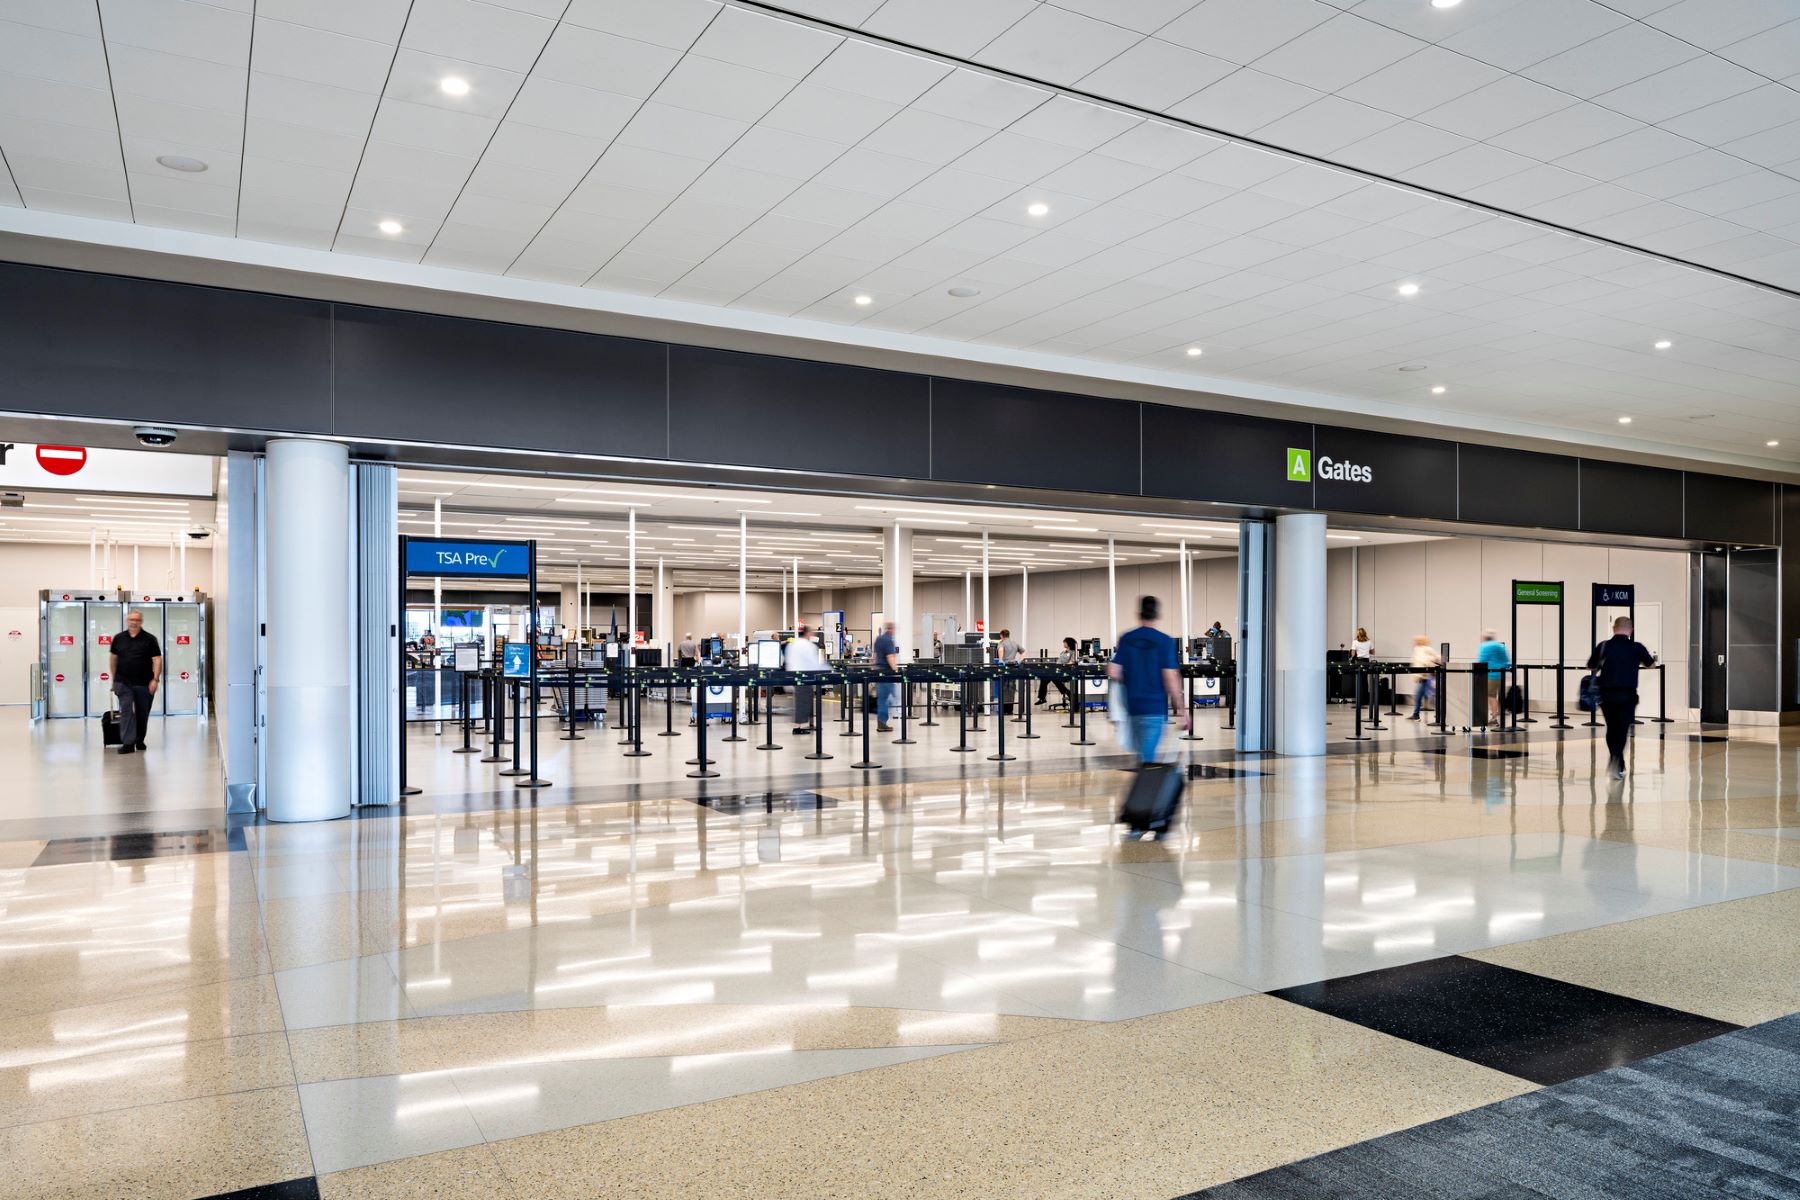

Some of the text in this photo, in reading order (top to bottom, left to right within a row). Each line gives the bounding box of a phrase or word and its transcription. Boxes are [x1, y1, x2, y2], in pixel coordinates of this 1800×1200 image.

[1293, 454, 1372, 483] A Gates
[435, 551, 462, 565] TSA
[1535, 590, 1558, 599] Screening
[1614, 591, 1629, 600] KCM
